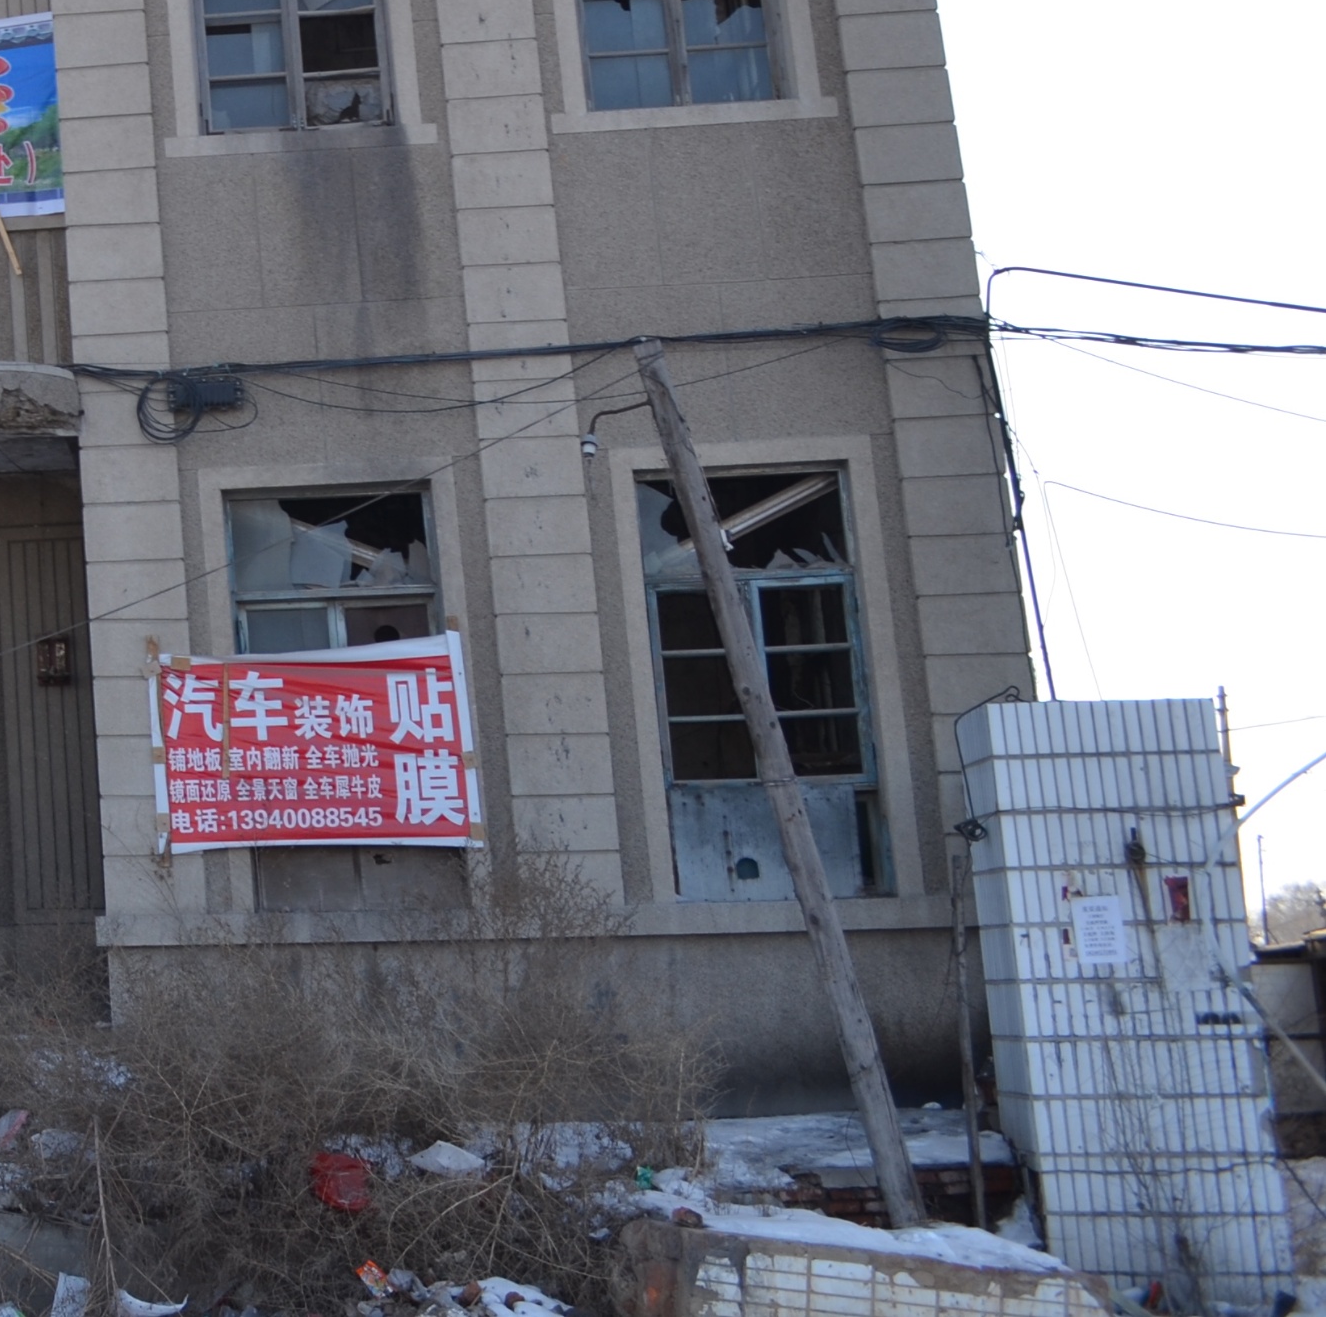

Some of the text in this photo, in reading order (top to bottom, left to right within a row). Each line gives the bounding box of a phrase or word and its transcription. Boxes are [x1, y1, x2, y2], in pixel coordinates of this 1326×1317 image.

[229, 746, 299, 771] 室内翻新
[305, 744, 379, 770] 全车抛光
[169, 779, 231, 804] 镜面还原
